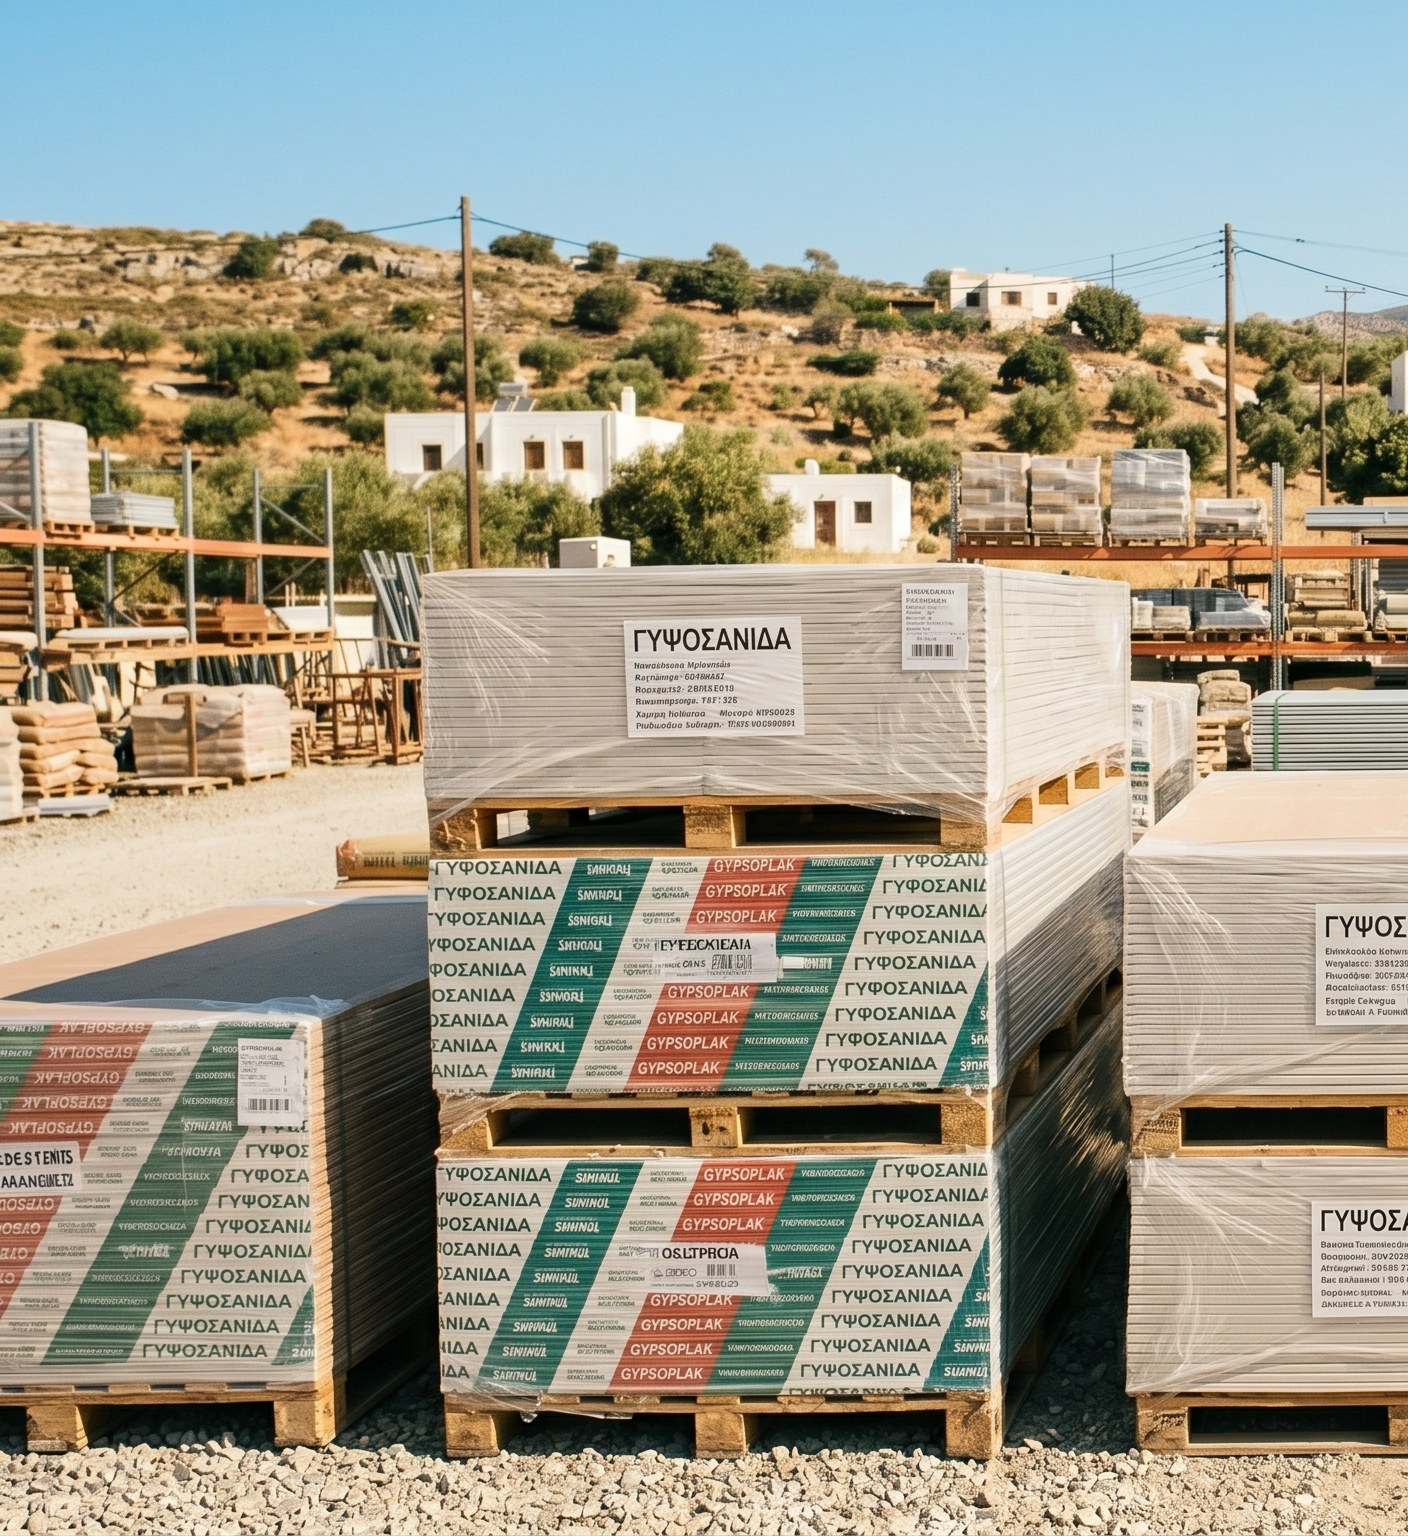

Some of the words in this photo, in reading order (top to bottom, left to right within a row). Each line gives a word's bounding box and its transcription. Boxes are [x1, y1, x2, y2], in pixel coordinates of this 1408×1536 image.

[634, 627, 792, 653] ΓΥΨΟΣΑΝΙΔΑ
[714, 858, 796, 872] GYPSOPLAK
[706, 884, 787, 898] GYPSOPLAK
[696, 910, 777, 923] GYPSOPLAK
[668, 985, 750, 999] GYPSOPLAK
[657, 1011, 739, 1024] GYPSOPLAK
[647, 1036, 729, 1050] GYPSOPLAK
[638, 1061, 720, 1075] GYPSOPLAK
[704, 1168, 785, 1181] GYPSOPLAK
[694, 1193, 775, 1206] GYPSOPLAK
[682, 1217, 765, 1231] GYPSOPLAK
[863, 1213, 984, 1228] ΓΥΨΟΣΑΝΙΔΑ
[194, 1244, 312, 1258] ΓΥΨΟΣΑΝΙΔ
[852, 1238, 972, 1254] ΓΥΨΟΣΑΝΙΔΑ
[181, 1269, 306, 1283] ΓΥΨΟΣΑΝΙΔΑ
[842, 1263, 963, 1278] ΓΥΨΟΣΑΝΙΔΑ
[166, 1294, 292, 1308] ΓΥΨΟΣΑΝΙΔΑ
[650, 1293, 733, 1306] GYPSOPLAK
[832, 1289, 952, 1303] ΓΥΨΟΣΑΝΙΔΑ
[154, 1319, 280, 1334] ΓΥΨΟΣΑΝΙΔΑ
[641, 1318, 723, 1331] GYPSOPLAK
[821, 1313, 941, 1328] ΓΥΨΟΣΑΝΙΔΑ
[142, 1344, 268, 1358] ΓΥΨΟΣΑΝΙΔΑ
[630, 1343, 713, 1356] GYPSOPLAK
[811, 1338, 931, 1353] ΓΥΨΟΣΑΝΙΔΑ
[621, 1368, 703, 1380] GYPSOPLAK
[801, 1363, 921, 1377] ΓΥΨΟΣΑΝΙΔΑ
